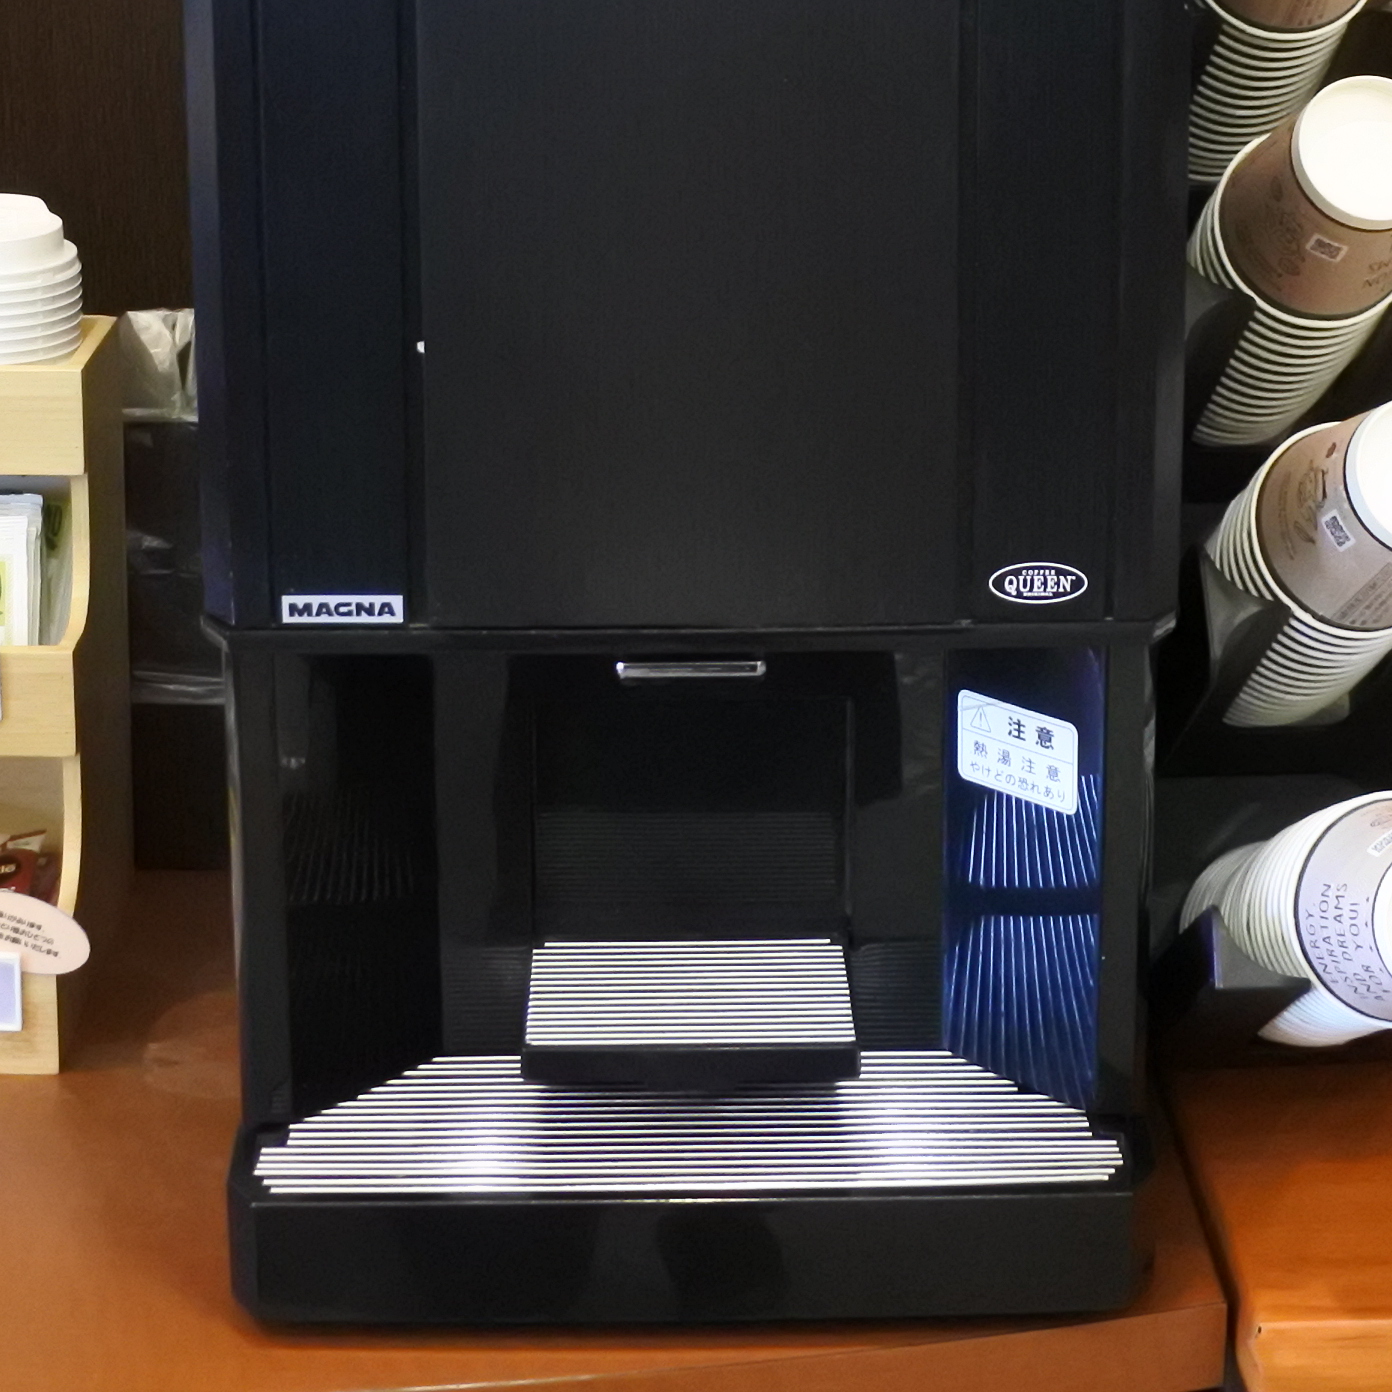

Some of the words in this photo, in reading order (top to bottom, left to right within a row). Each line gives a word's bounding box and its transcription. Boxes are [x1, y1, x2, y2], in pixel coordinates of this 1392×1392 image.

[1004, 576, 1072, 596] QUEEN
[288, 602, 396, 617] MAGNA
[1008, 716, 1055, 750] 注意
[974, 740, 1061, 783] 熱湯注意
[970, 761, 1065, 802] やけどの恐れあり
[1333, 882, 1354, 962] DREAMS
